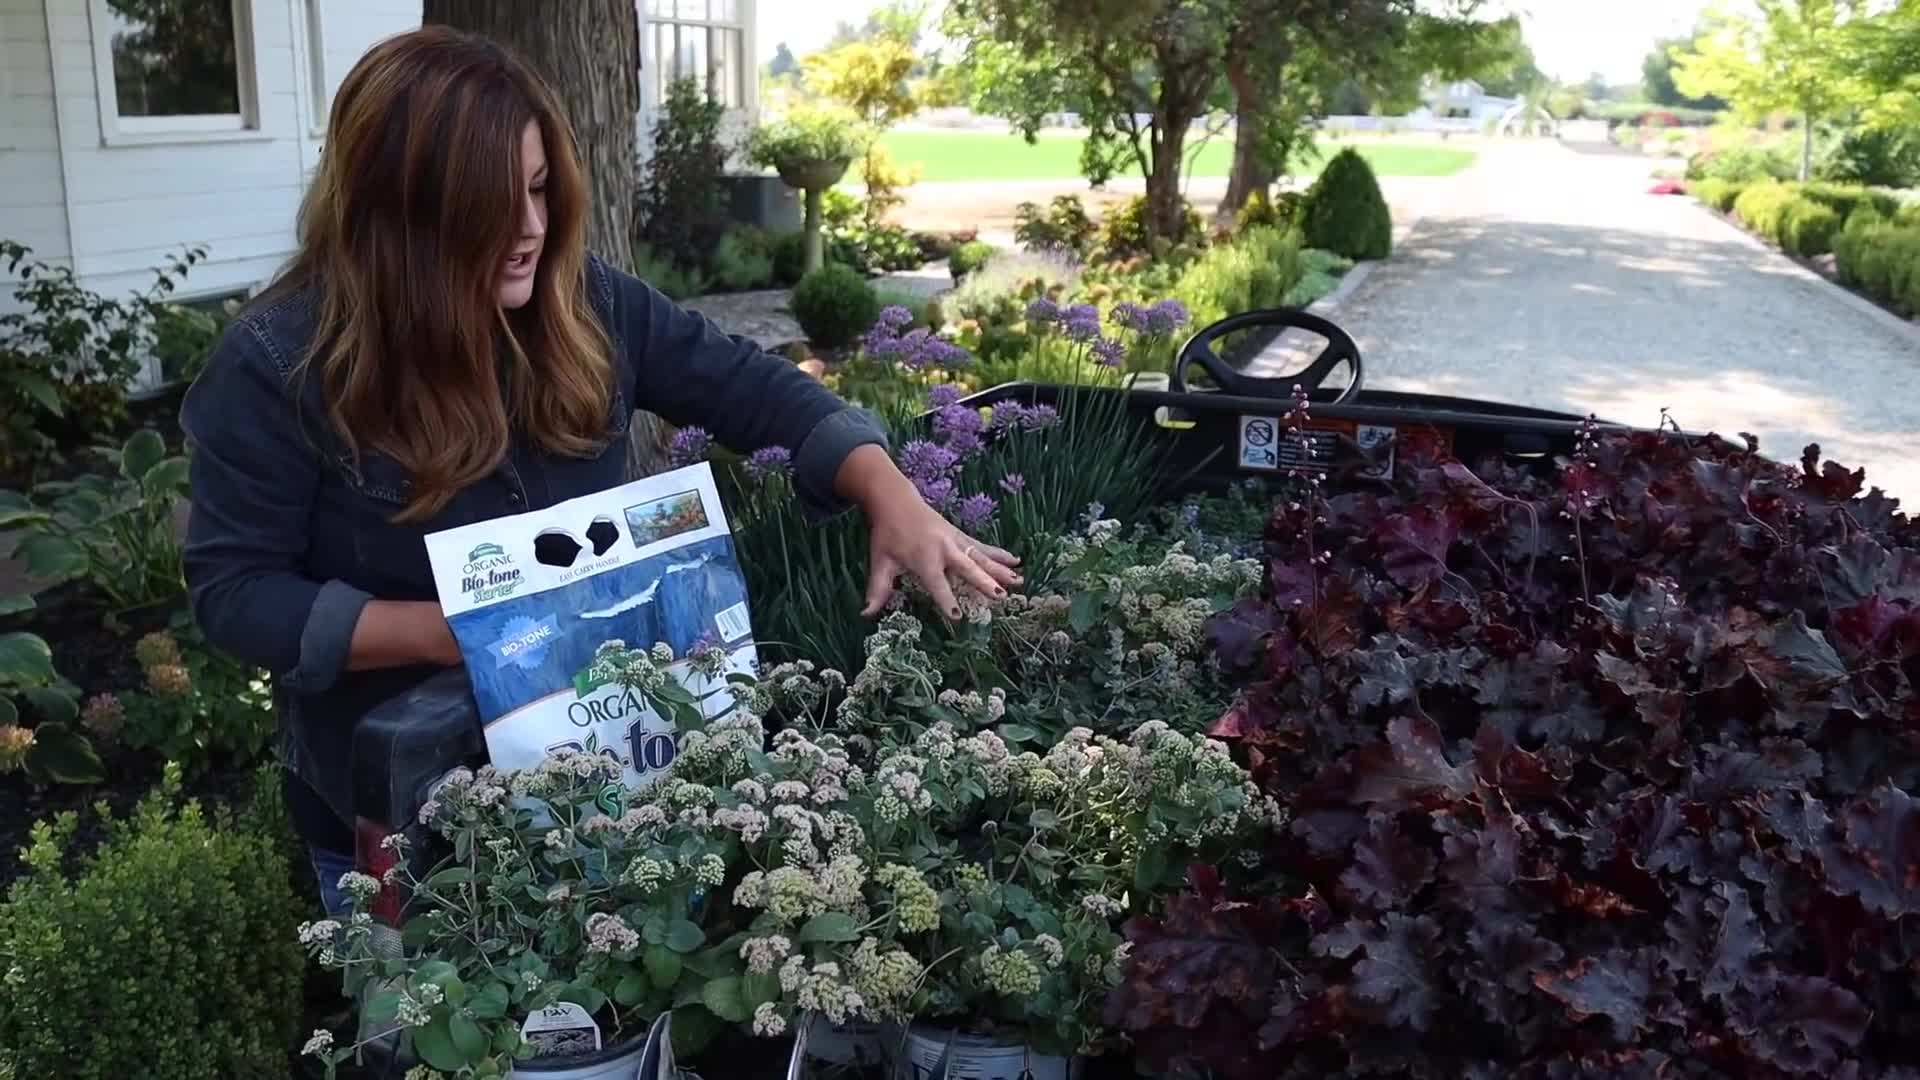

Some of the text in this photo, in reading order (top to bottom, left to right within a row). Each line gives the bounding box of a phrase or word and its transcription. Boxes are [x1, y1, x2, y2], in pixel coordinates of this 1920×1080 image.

[463, 554, 513, 574] ORGANIC
[461, 569, 520, 593] Bio-tone
[501, 625, 551, 656] BIO-TONE
